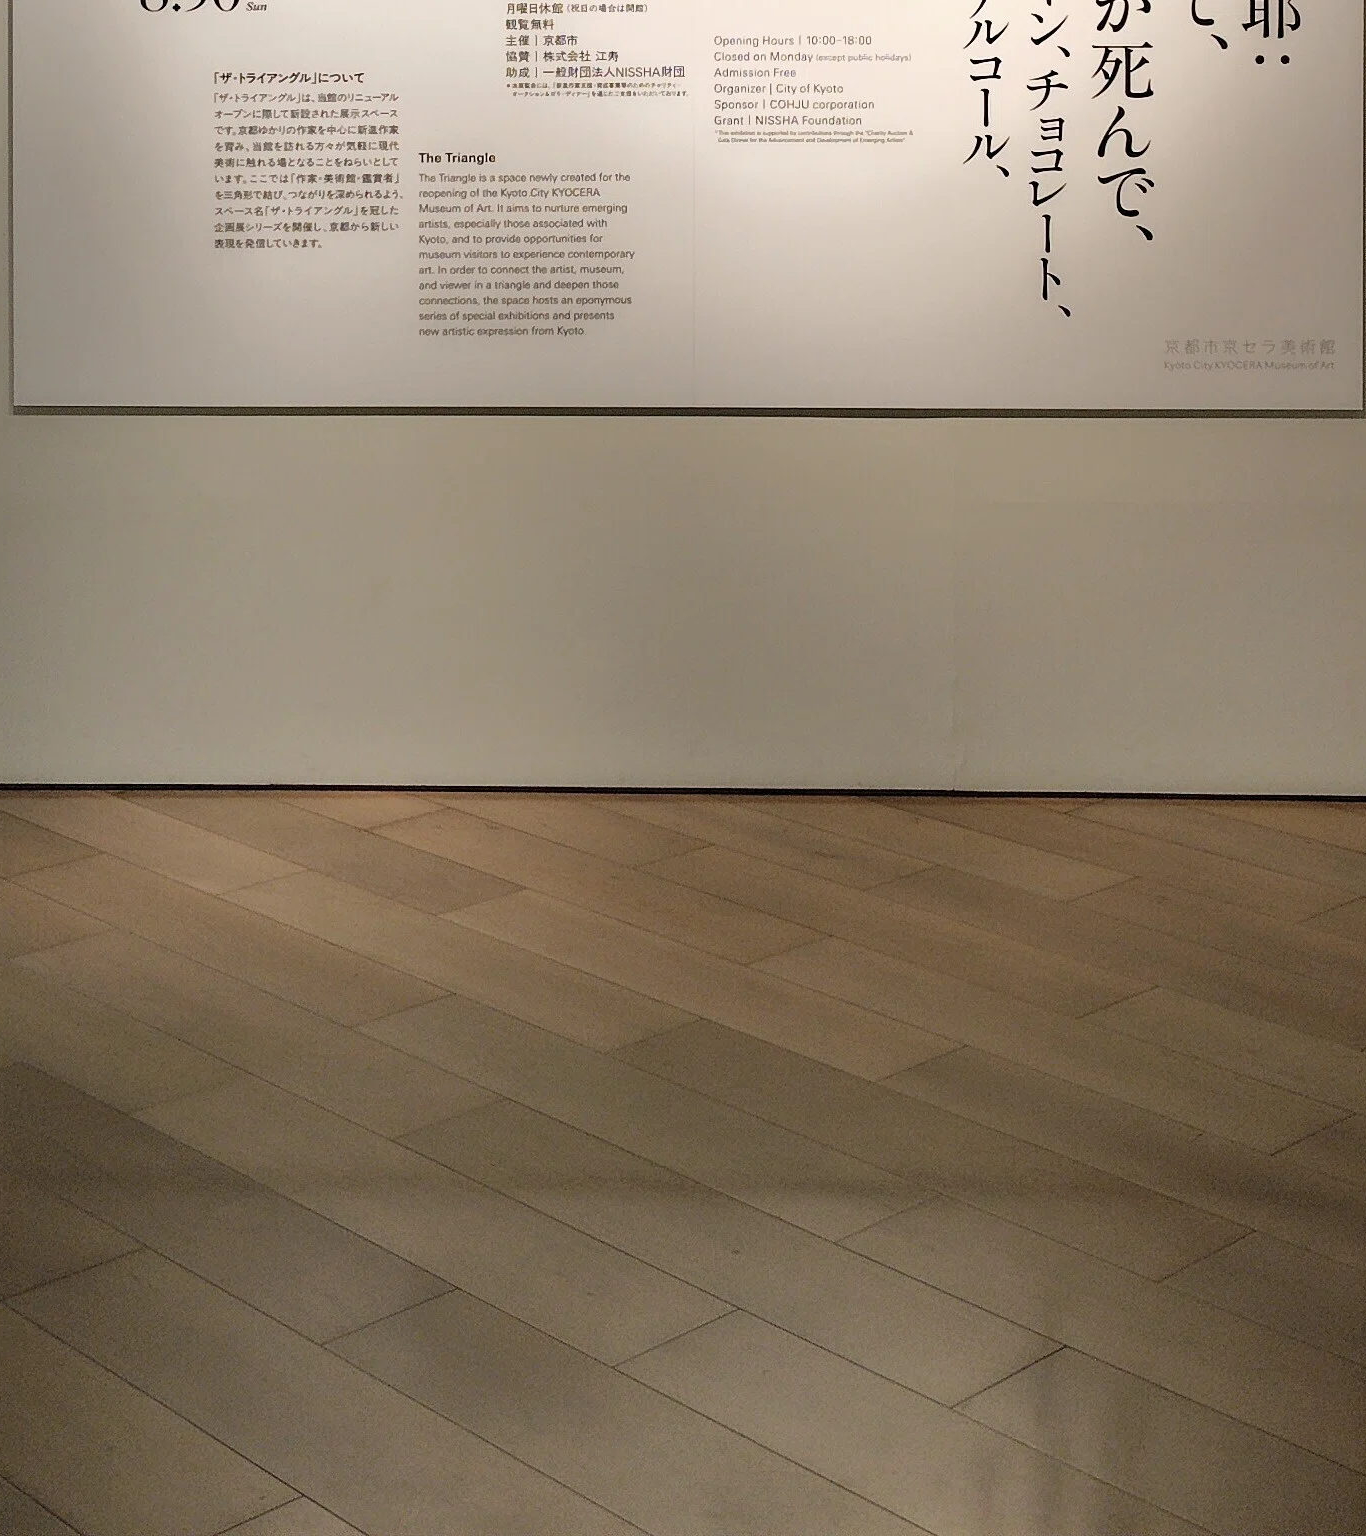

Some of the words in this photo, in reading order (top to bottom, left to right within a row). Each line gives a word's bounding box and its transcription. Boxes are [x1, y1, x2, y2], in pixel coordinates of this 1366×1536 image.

[246, 2, 267, 11] Sun
[506, 19, 554, 30] 観覧無料
[714, 36, 759, 48] Opening
[762, 36, 794, 45] Hours
[714, 52, 750, 62] Closed
[770, 51, 813, 63] Monday
[214, 72, 364, 84] 「ザ・トライアングル」について
[714, 68, 770, 77] Admission
[773, 68, 796, 77] Free
[714, 84, 766, 96] Organizer
[776, 84, 797, 95] City
[800, 83, 810, 93] of
[813, 84, 843, 95] Kyoto
[714, 99, 758, 111] Sponsor
[770, 99, 809, 109] COHJU
[812, 101, 874, 111] corporation
[714, 116, 743, 125] Grant
[755, 115, 799, 125] NISSHA
[802, 115, 862, 125] Foundation
[418, 153, 441, 163] The
[445, 152, 495, 165] Triangle
[419, 173, 436, 182] The
[439, 173, 476, 183] Triangle
[479, 174, 487, 182] is
[498, 175, 527, 183] space
[529, 173, 558, 183] newly
[560, 173, 596, 182] created
[599, 172, 612, 182] for
[615, 172, 630, 182] the
[419, 189, 467, 199] reopening
[470, 188, 479, 197] of
[482, 189, 498, 198] the
[501, 188, 528, 199] Kyoto
[529, 188, 549, 199] City
[552, 188, 601, 197] KYOCERA
[419, 204, 461, 213] Museum
[464, 204, 474, 213] of
[476, 204, 493, 213] Art.
[497, 203, 503, 212] It
[506, 204, 529, 212] aims
[532, 204, 542, 212] to
[544, 204, 579, 213] nurture
[582, 203, 628, 215] emerging
[419, 220, 450, 229] artists,
[454, 219, 501, 229] especially
[504, 219, 530, 228] those
[532, 219, 584, 228] associated
[586, 219, 607, 228] with
[419, 235, 449, 245] Kyoto,
[452, 235, 470, 244] and
[473, 236, 483, 244] to
[485, 234, 521, 245] provide
[523, 234, 587, 245] opportunities
[590, 234, 603, 243] for
[463, 249, 498, 259] visitors
[500, 251, 510, 259] to
[513, 250, 565, 260] experience
[567, 250, 635, 260] contemporary
[419, 266, 434, 274] art.
[438, 265, 447, 274] In
[450, 265, 475, 274] order
[478, 266, 488, 274] to
[490, 266, 529, 274] connect
[532, 265, 547, 274] the
[550, 265, 577, 275] artist,
[580, 266, 624, 275] museum,
[419, 280, 437, 290] and
[439, 281, 471, 290] viewer
[474, 281, 483, 289] in
[495, 280, 530, 291] triangle
[533, 280, 551, 289] and
[554, 280, 590, 291] deepen
[592, 280, 619, 289] those
[419, 296, 480, 306] connections,
[483, 296, 498, 305] the
[501, 297, 530, 307] space
[532, 296, 558, 304] hosts
[576, 297, 632, 306] eponymous
[419, 311, 447, 320] series
[450, 311, 460, 320] of
[462, 311, 495, 322] special
[498, 311, 550, 320] exhibitions
[552, 311, 571, 320] and
[573, 312, 615, 322] presents
[442, 327, 475, 336] artistic
[477, 327, 529, 337] expression
[531, 326, 554, 335] from
[1165, 338, 1336, 356] 京都市京セラ美術館
